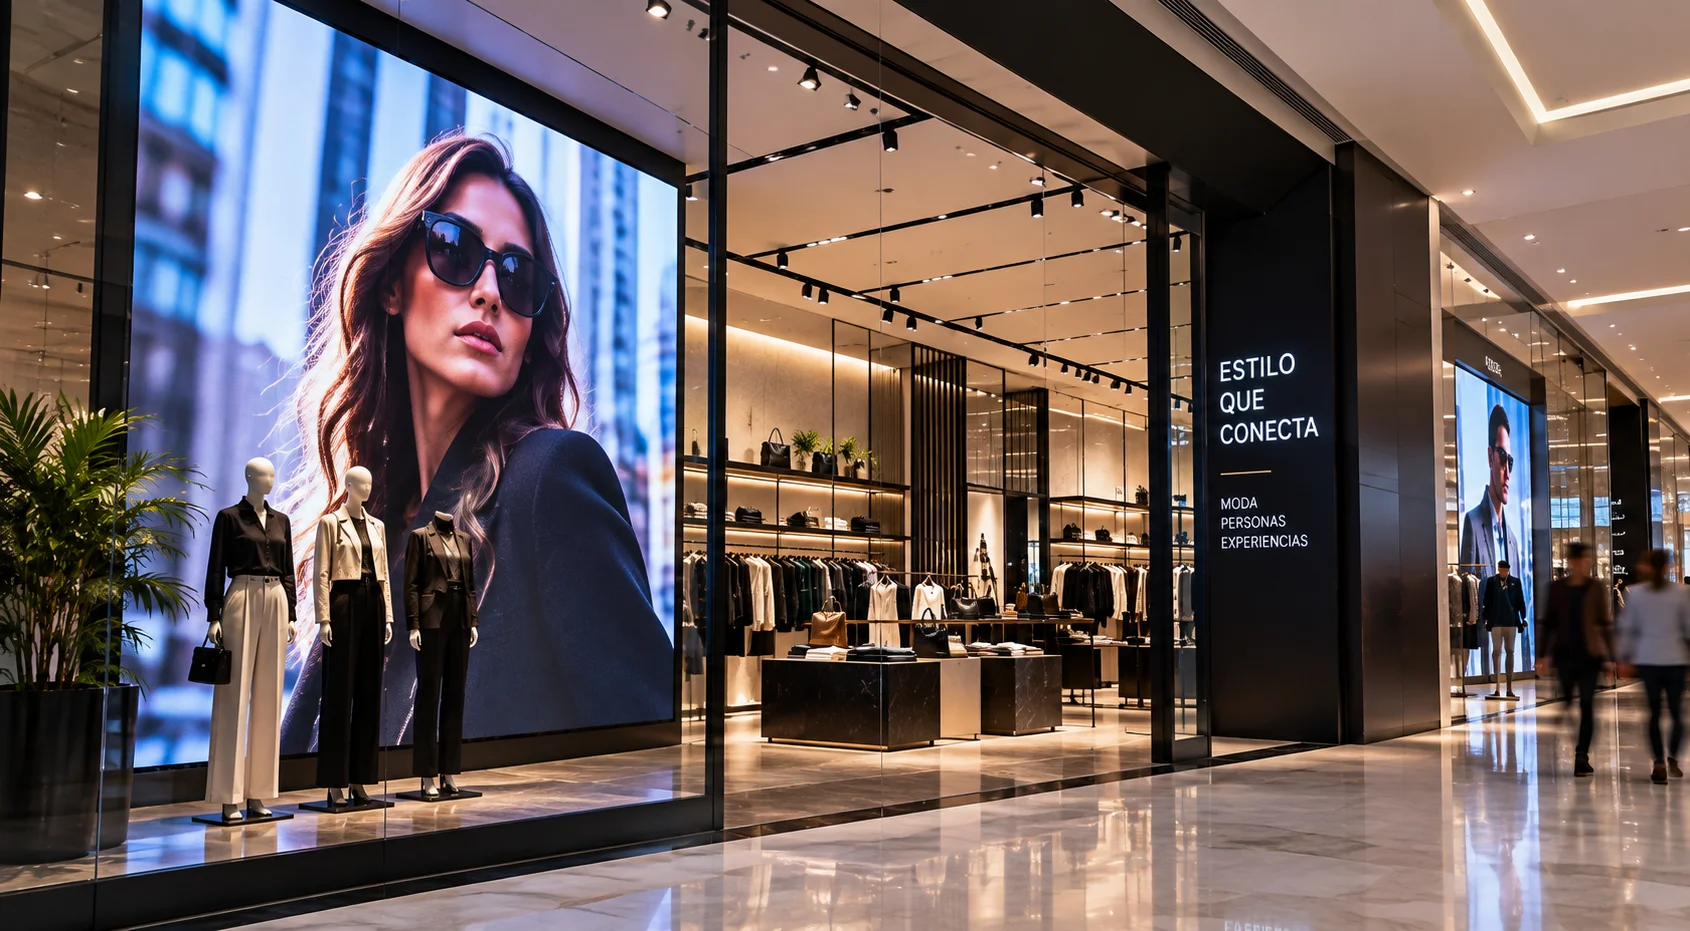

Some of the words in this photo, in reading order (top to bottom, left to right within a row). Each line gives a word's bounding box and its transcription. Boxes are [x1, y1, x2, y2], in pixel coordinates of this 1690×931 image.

[1220, 353, 1296, 382] ESTILO
[1220, 388, 1265, 414] QUE
[1220, 416, 1319, 444] CONECTA
[1220, 496, 1258, 510] MODA
[1221, 514, 1286, 530] PERSONAS
[1221, 534, 1309, 549] EXPERIENCIAS
